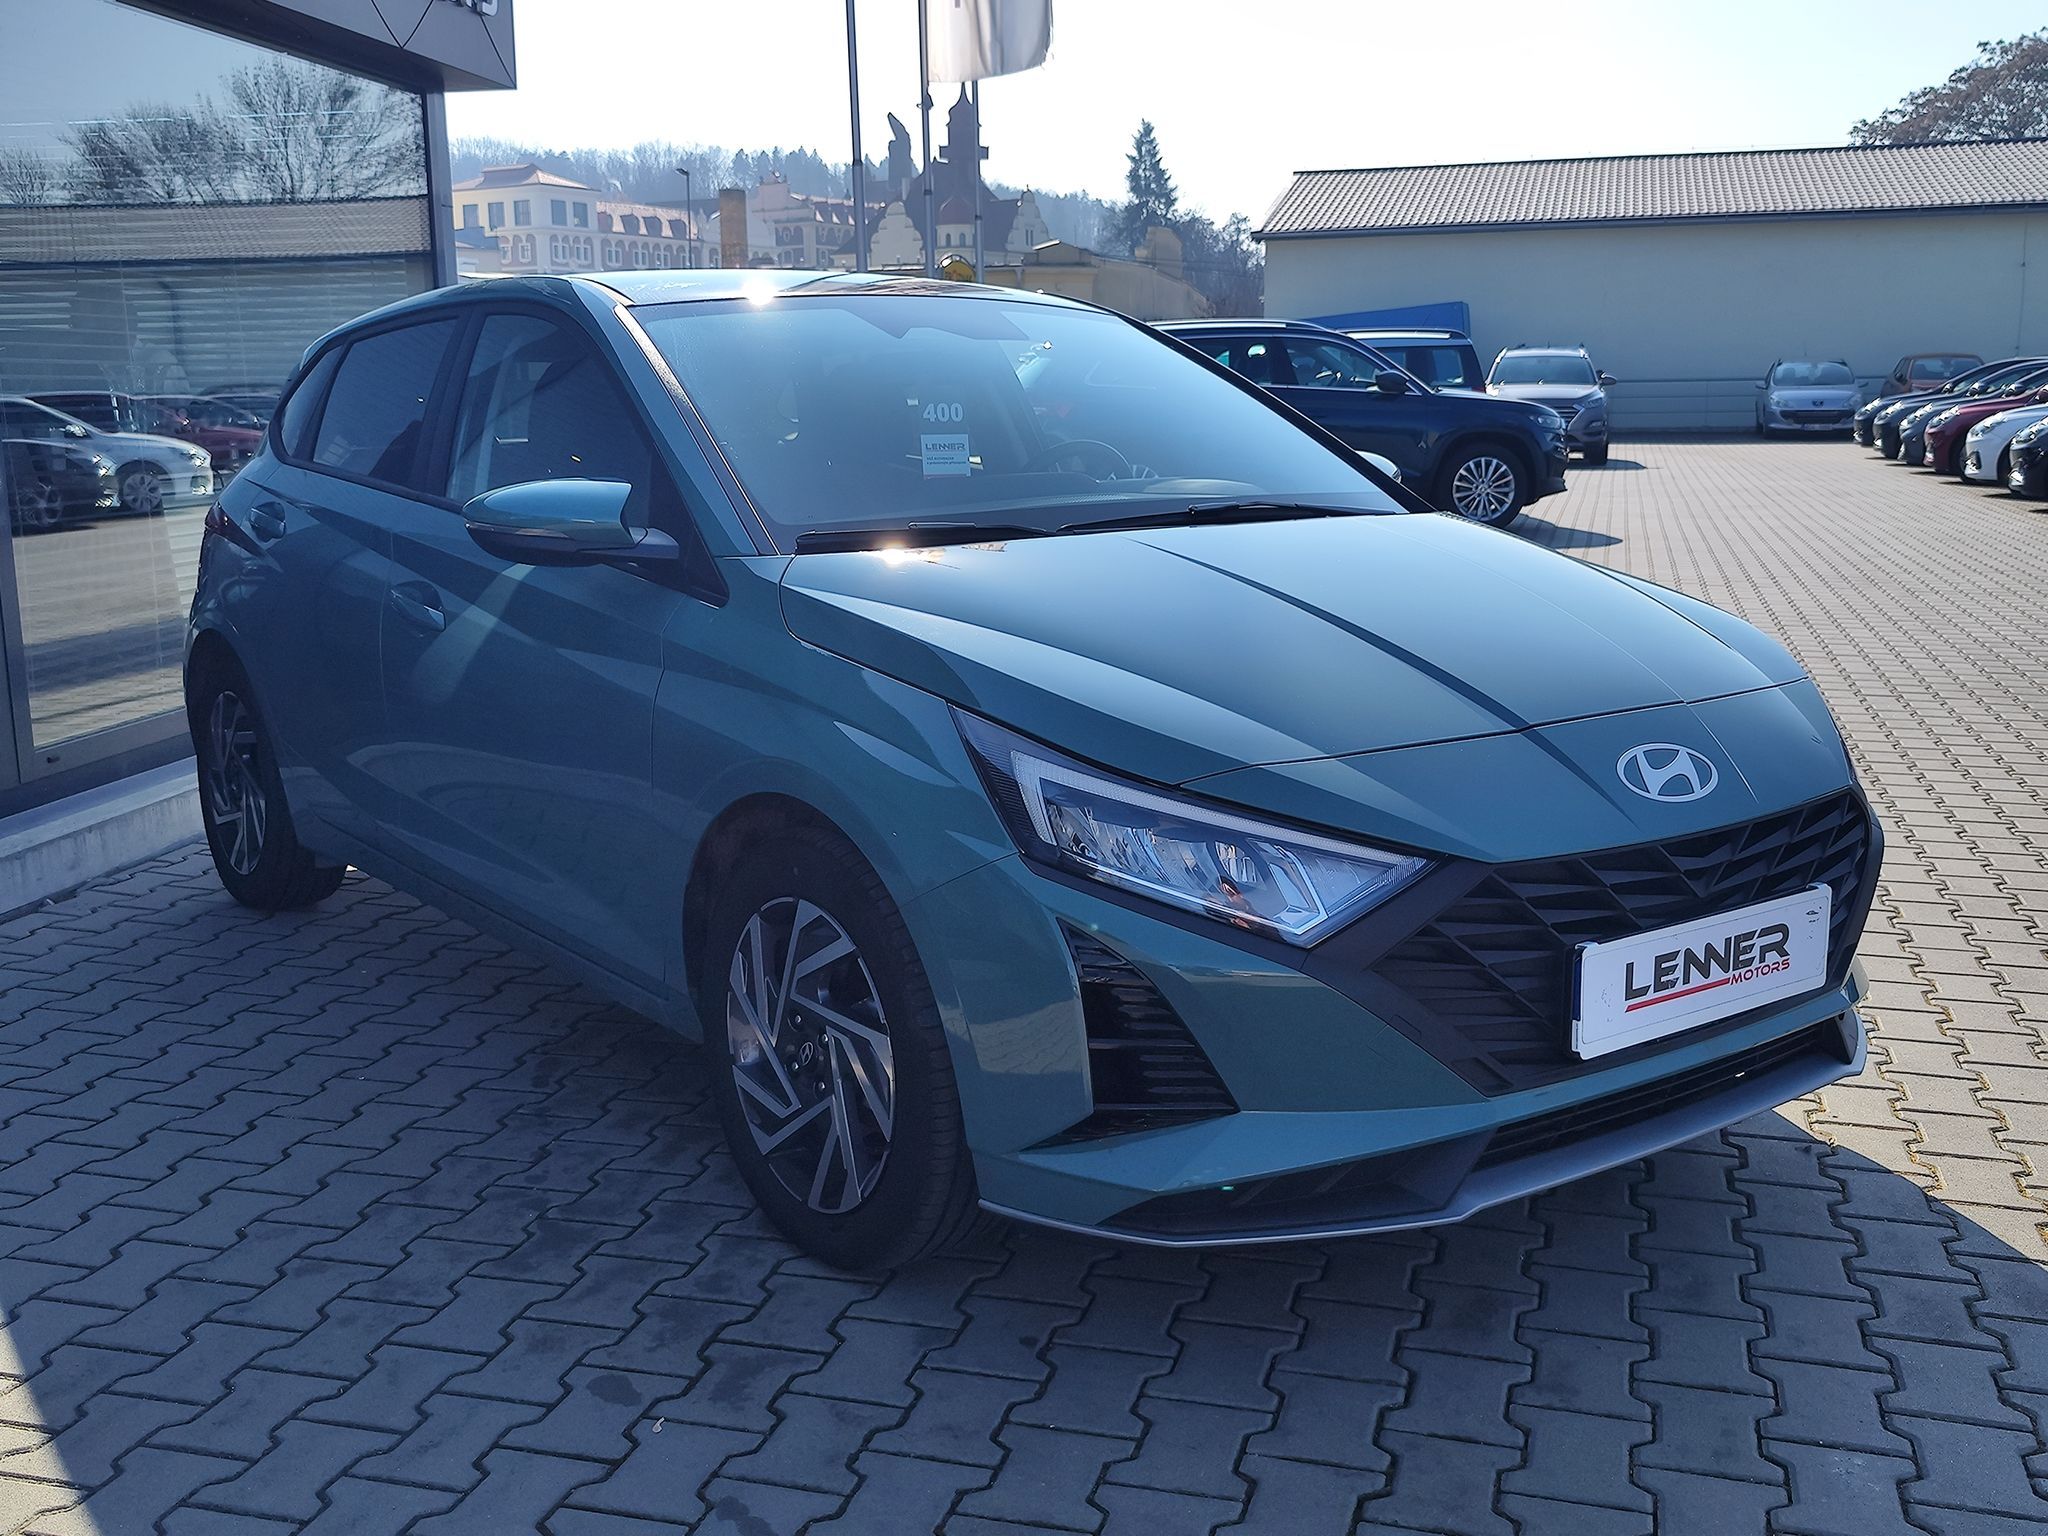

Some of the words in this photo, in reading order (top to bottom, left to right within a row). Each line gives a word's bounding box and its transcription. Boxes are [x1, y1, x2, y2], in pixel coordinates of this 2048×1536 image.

[923, 403, 963, 421] 400
[1625, 923, 1790, 1001] LENNER
[1730, 957, 1790, 985] MOTORS
